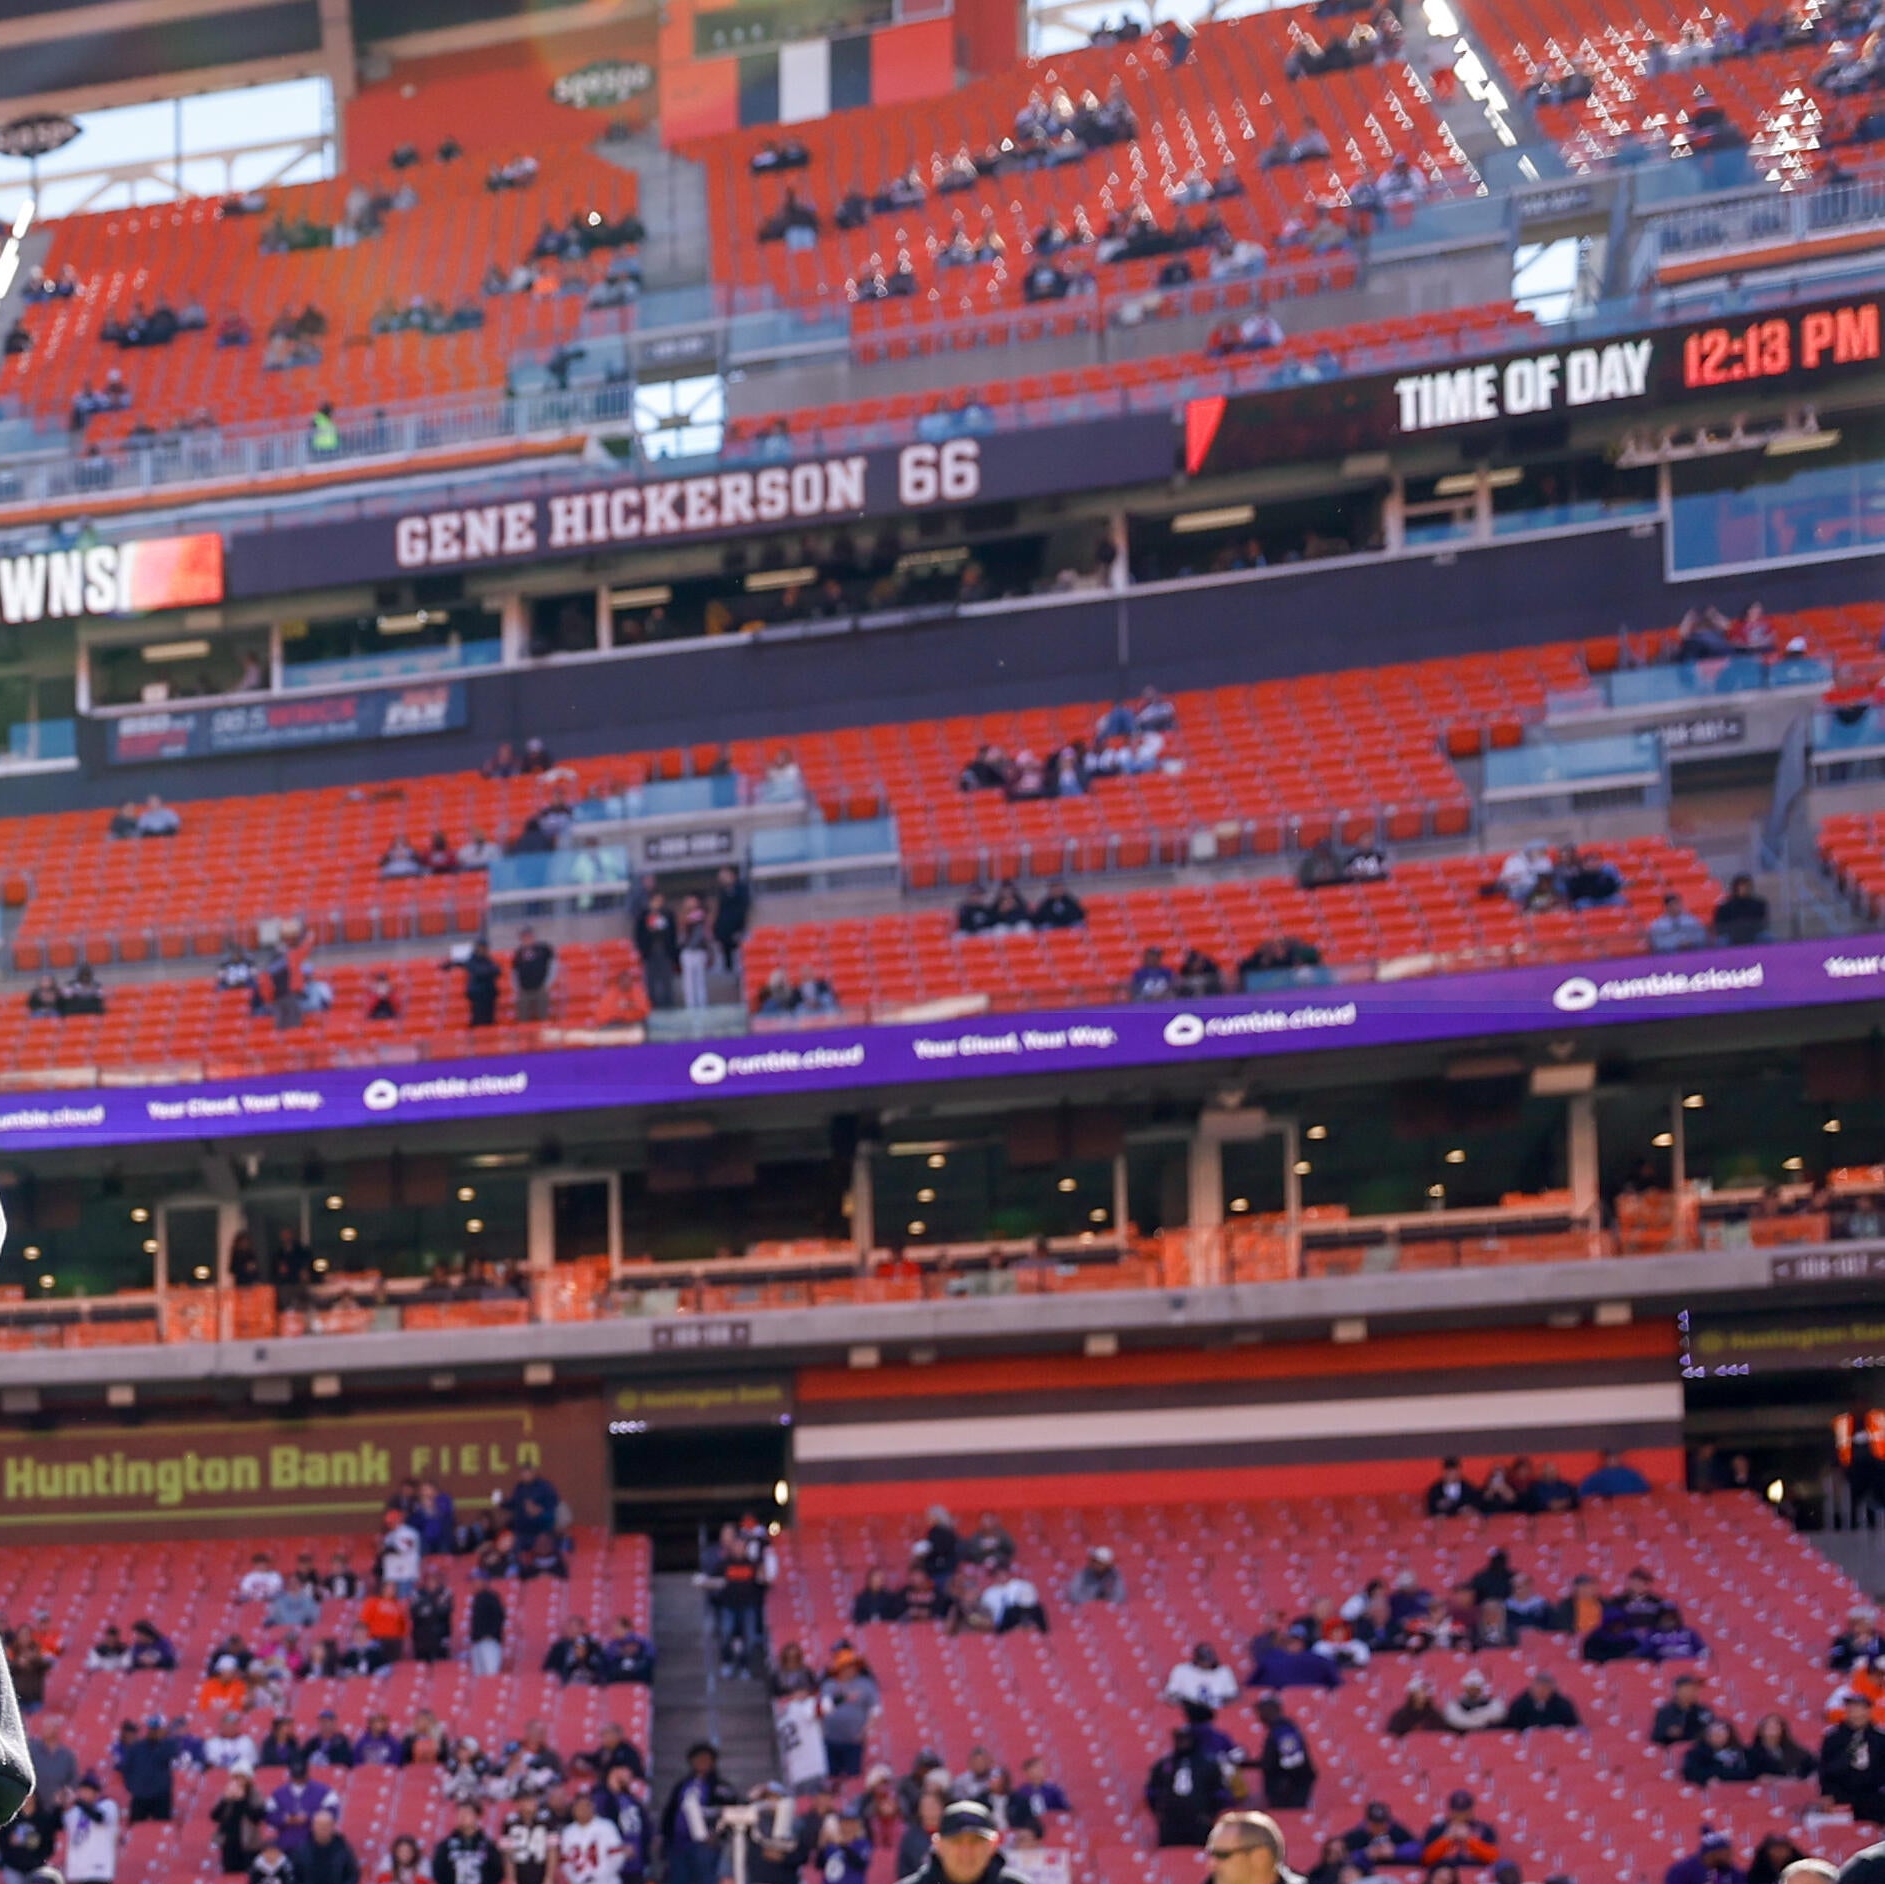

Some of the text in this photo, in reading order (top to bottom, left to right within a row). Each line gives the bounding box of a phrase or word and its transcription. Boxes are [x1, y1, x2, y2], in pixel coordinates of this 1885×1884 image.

[1394, 303, 1881, 432] TIME OF DAY 12:13 PM
[396, 438, 980, 568] GENE HICKERSON 66
[728, 1045, 864, 1075] rumble.cloud
[913, 1037, 956, 1059] Your
[399, 1072, 528, 1101] rumble.cloud
[147, 1101, 185, 1121] Your
[242, 1094, 279, 1113] Your
[5, 1442, 541, 1504] Huntington Bank FIELD
